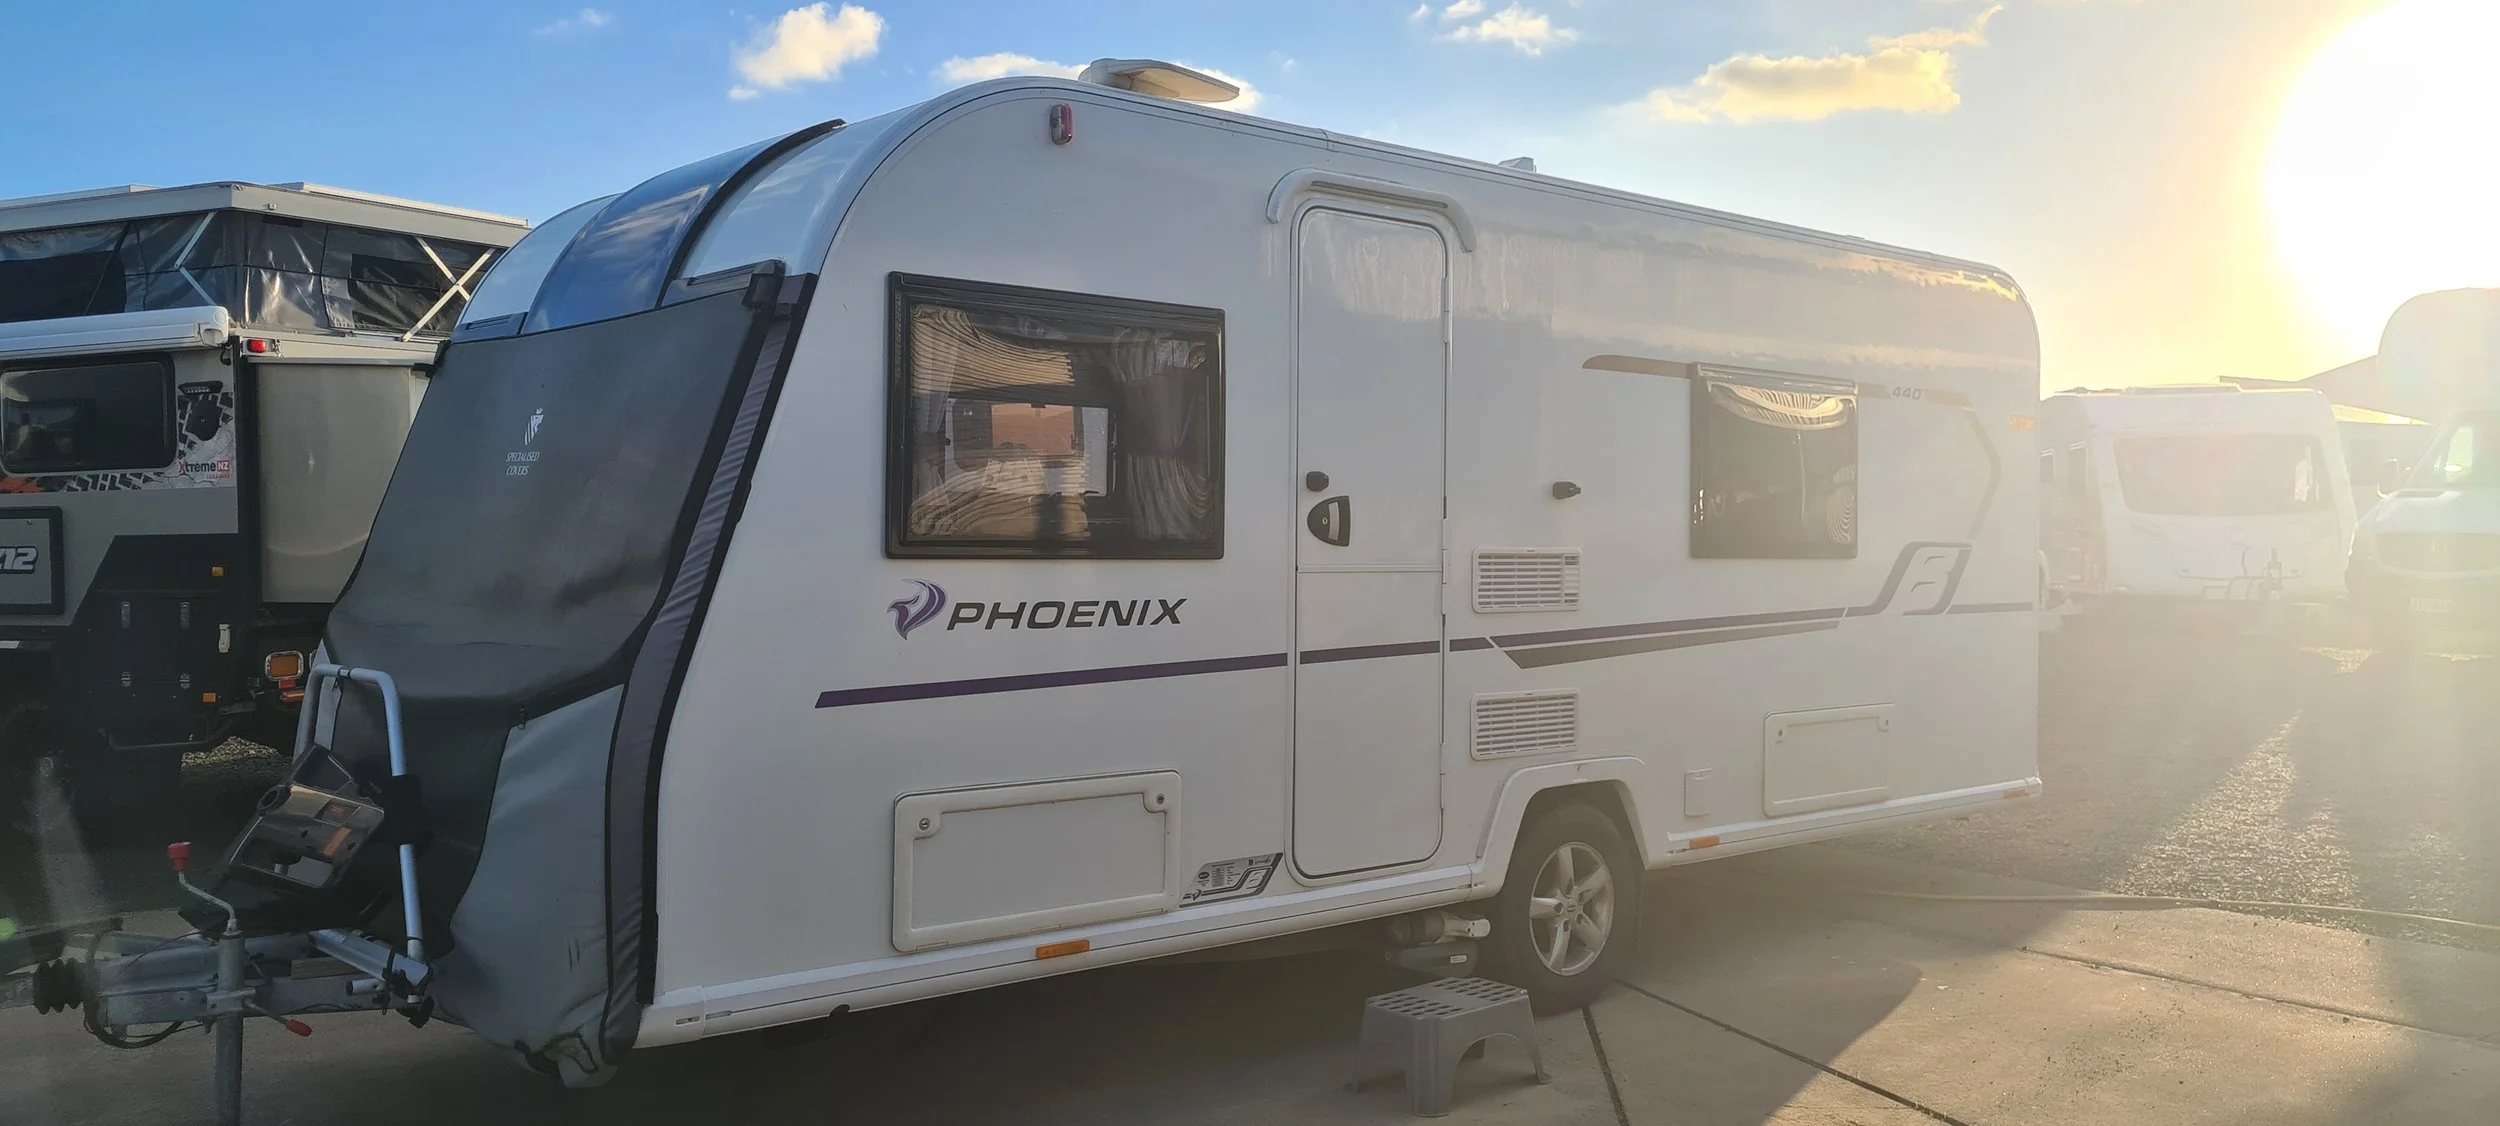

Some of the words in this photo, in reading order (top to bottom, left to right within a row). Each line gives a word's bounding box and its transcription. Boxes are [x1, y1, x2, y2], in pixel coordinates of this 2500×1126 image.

[1891, 386, 1922, 401] 440
[505, 451, 540, 462] SPECIALISED
[505, 465, 529, 476] COVERS
[946, 597, 1188, 632] PHOENIX
